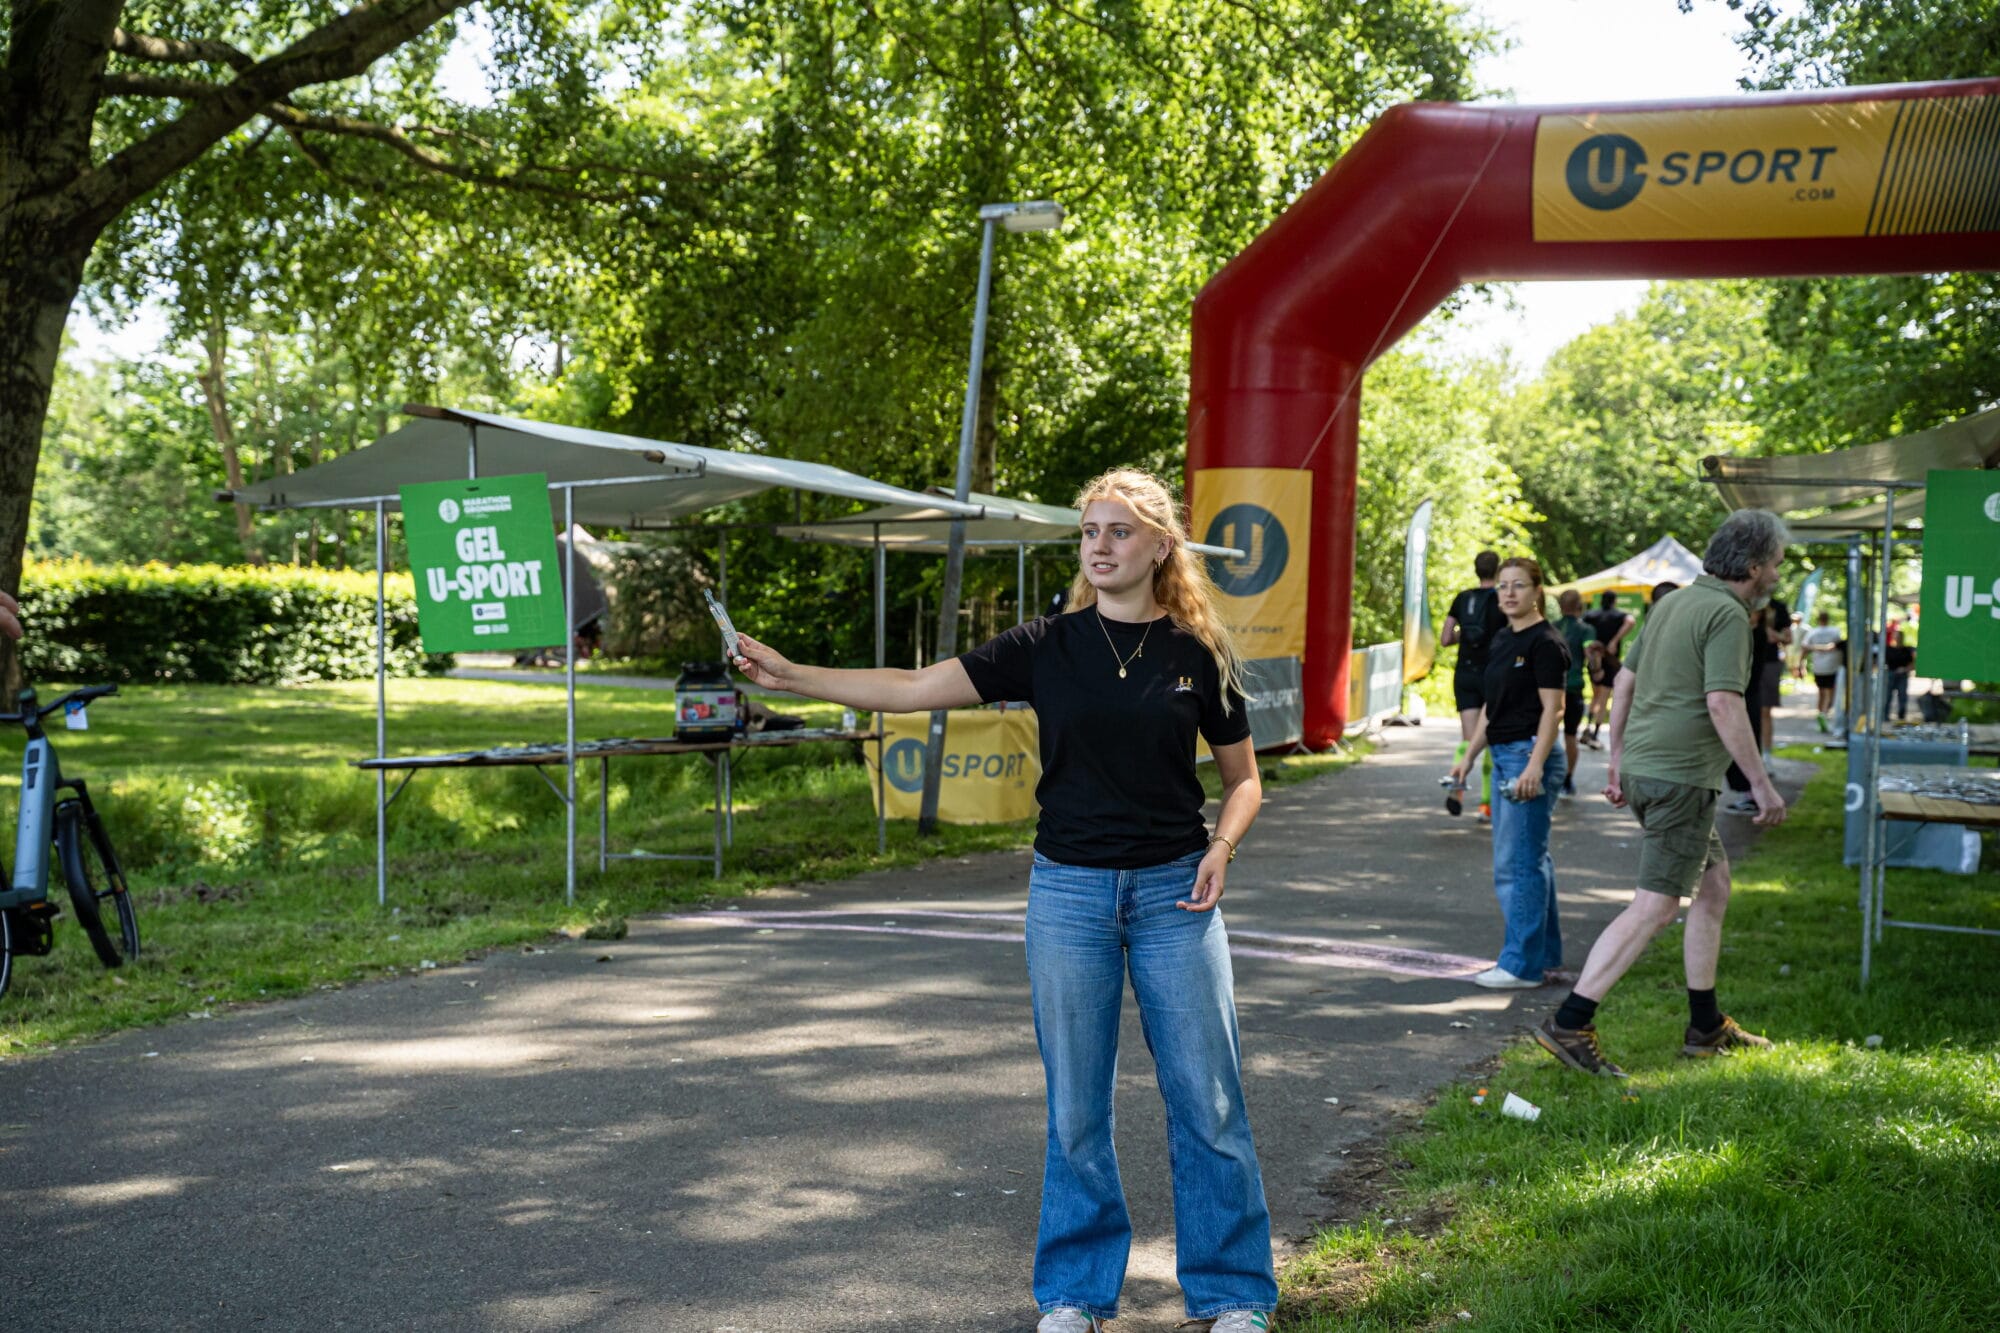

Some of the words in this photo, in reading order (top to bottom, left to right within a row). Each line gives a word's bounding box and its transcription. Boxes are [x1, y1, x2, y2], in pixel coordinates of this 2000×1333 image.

[1658, 146, 1837, 186] SPORT
[455, 526, 506, 563] GEL
[426, 560, 542, 602] U-SPORT
[897, 748, 921, 782] U
[942, 752, 1026, 779] SPORT
